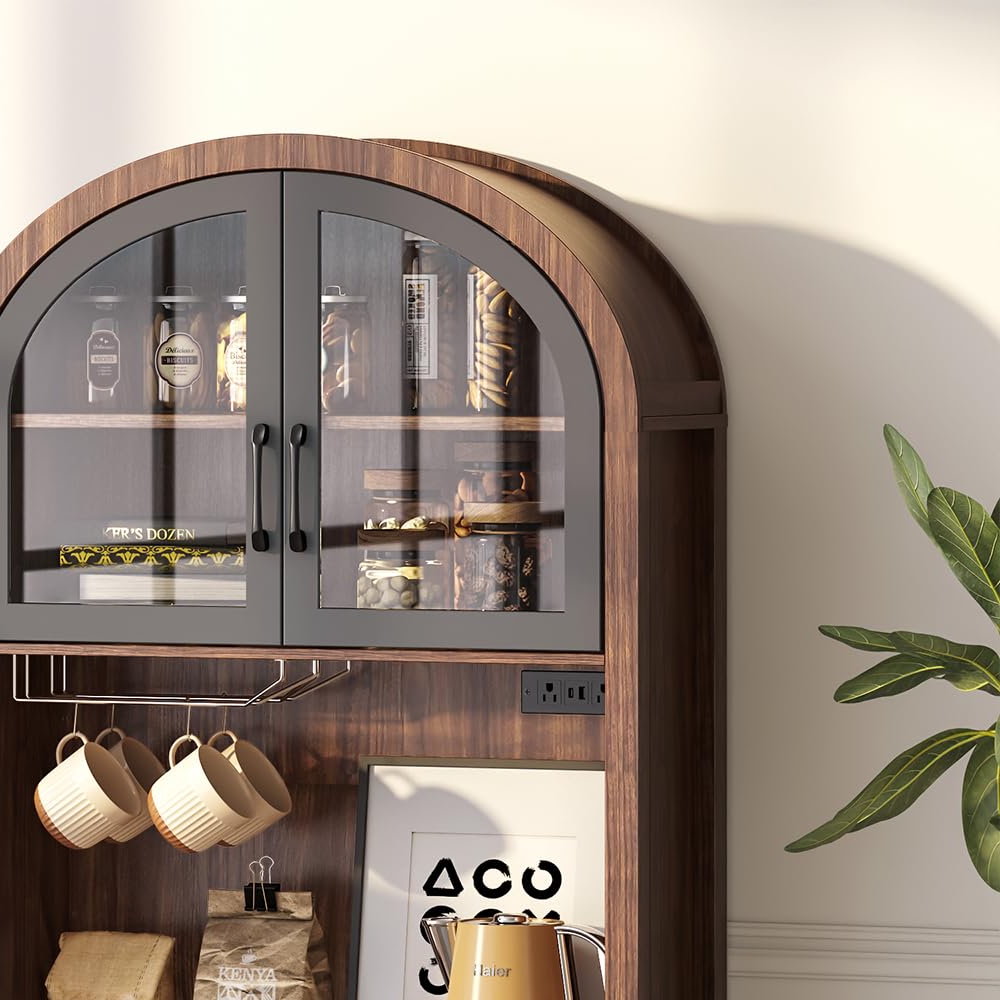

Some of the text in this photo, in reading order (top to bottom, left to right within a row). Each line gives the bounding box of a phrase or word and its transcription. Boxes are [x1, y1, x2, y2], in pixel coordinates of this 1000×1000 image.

[147, 528, 196, 541] DOZEN
[218, 966, 277, 981] KENYA
[473, 963, 512, 977] Haier
